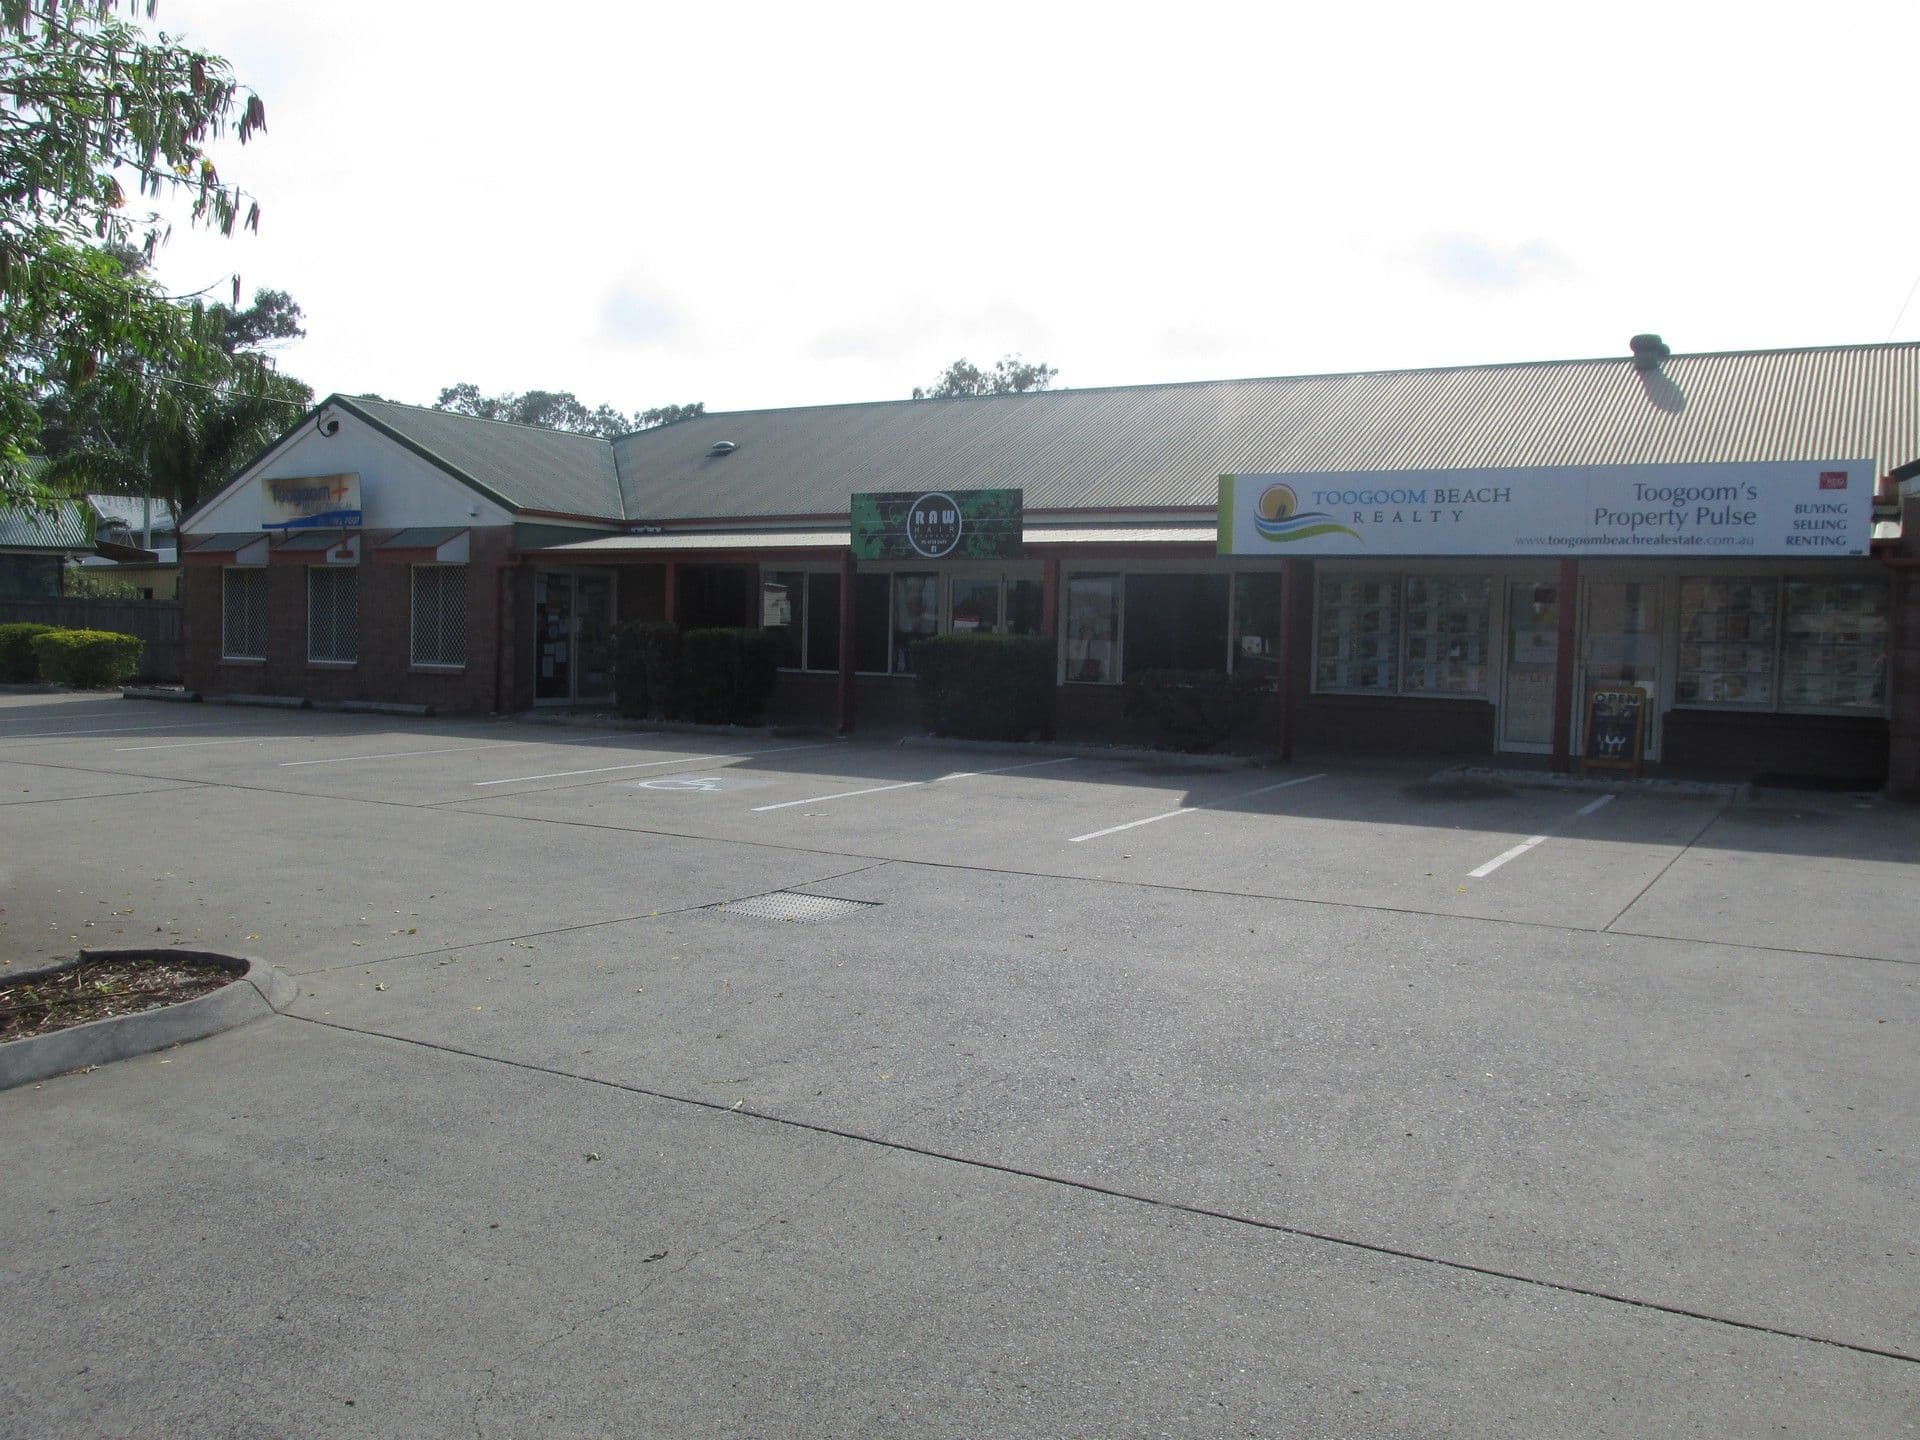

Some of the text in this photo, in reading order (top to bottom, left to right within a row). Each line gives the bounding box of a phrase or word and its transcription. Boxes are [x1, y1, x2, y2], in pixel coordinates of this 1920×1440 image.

[1312, 487, 1513, 505] TOOGOOM BEACH
[1632, 482, 1758, 507] Toogoom's
[1793, 503, 1849, 515] BUYING
[915, 510, 955, 524] RAW
[1353, 510, 1465, 523] REALTY
[1595, 506, 1758, 531] Property Pulse
[1792, 519, 1847, 530] SELLING
[1514, 535, 1755, 549] www.toogoombeachrealestate.com.au
[1785, 535, 1847, 546] RENTING
[1594, 692, 1639, 704] OPEN
